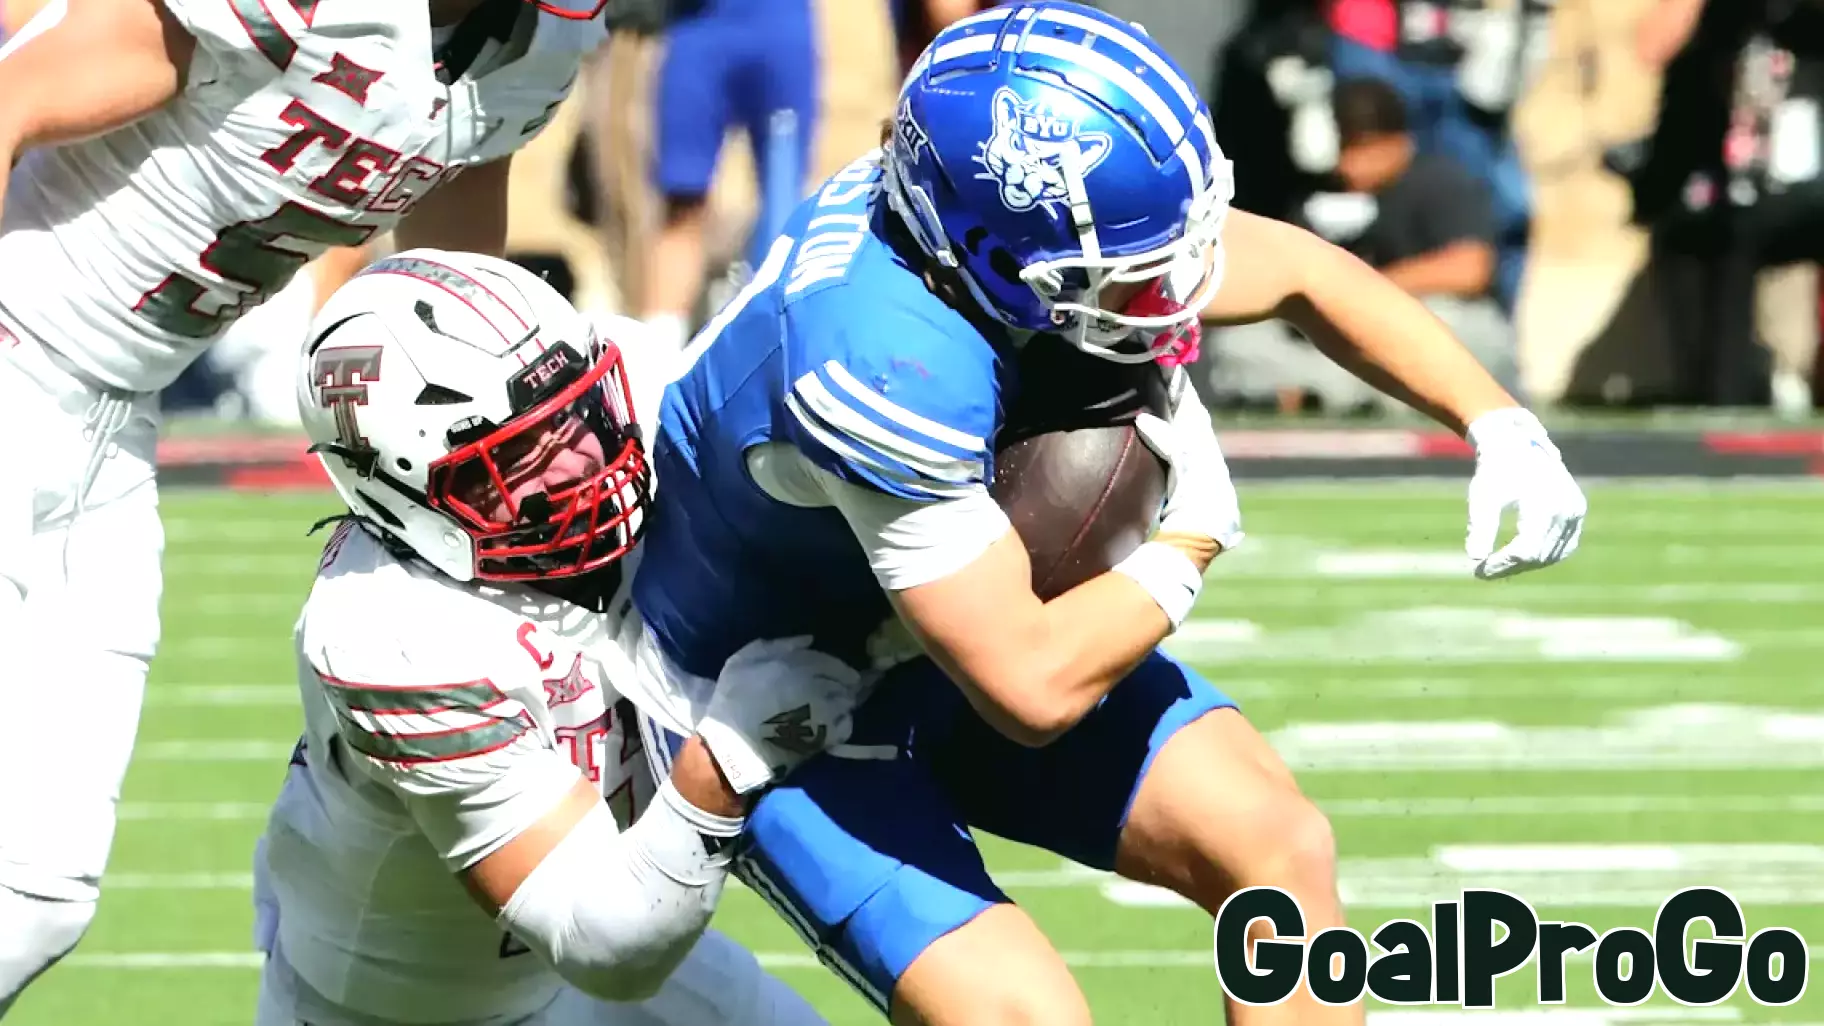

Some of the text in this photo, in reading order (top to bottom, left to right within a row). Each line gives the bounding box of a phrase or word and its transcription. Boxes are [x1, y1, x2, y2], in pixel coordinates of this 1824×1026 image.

[1023, 115, 1068, 137] BYU
[261, 98, 465, 214] TEC
[523, 350, 569, 389] TECH
